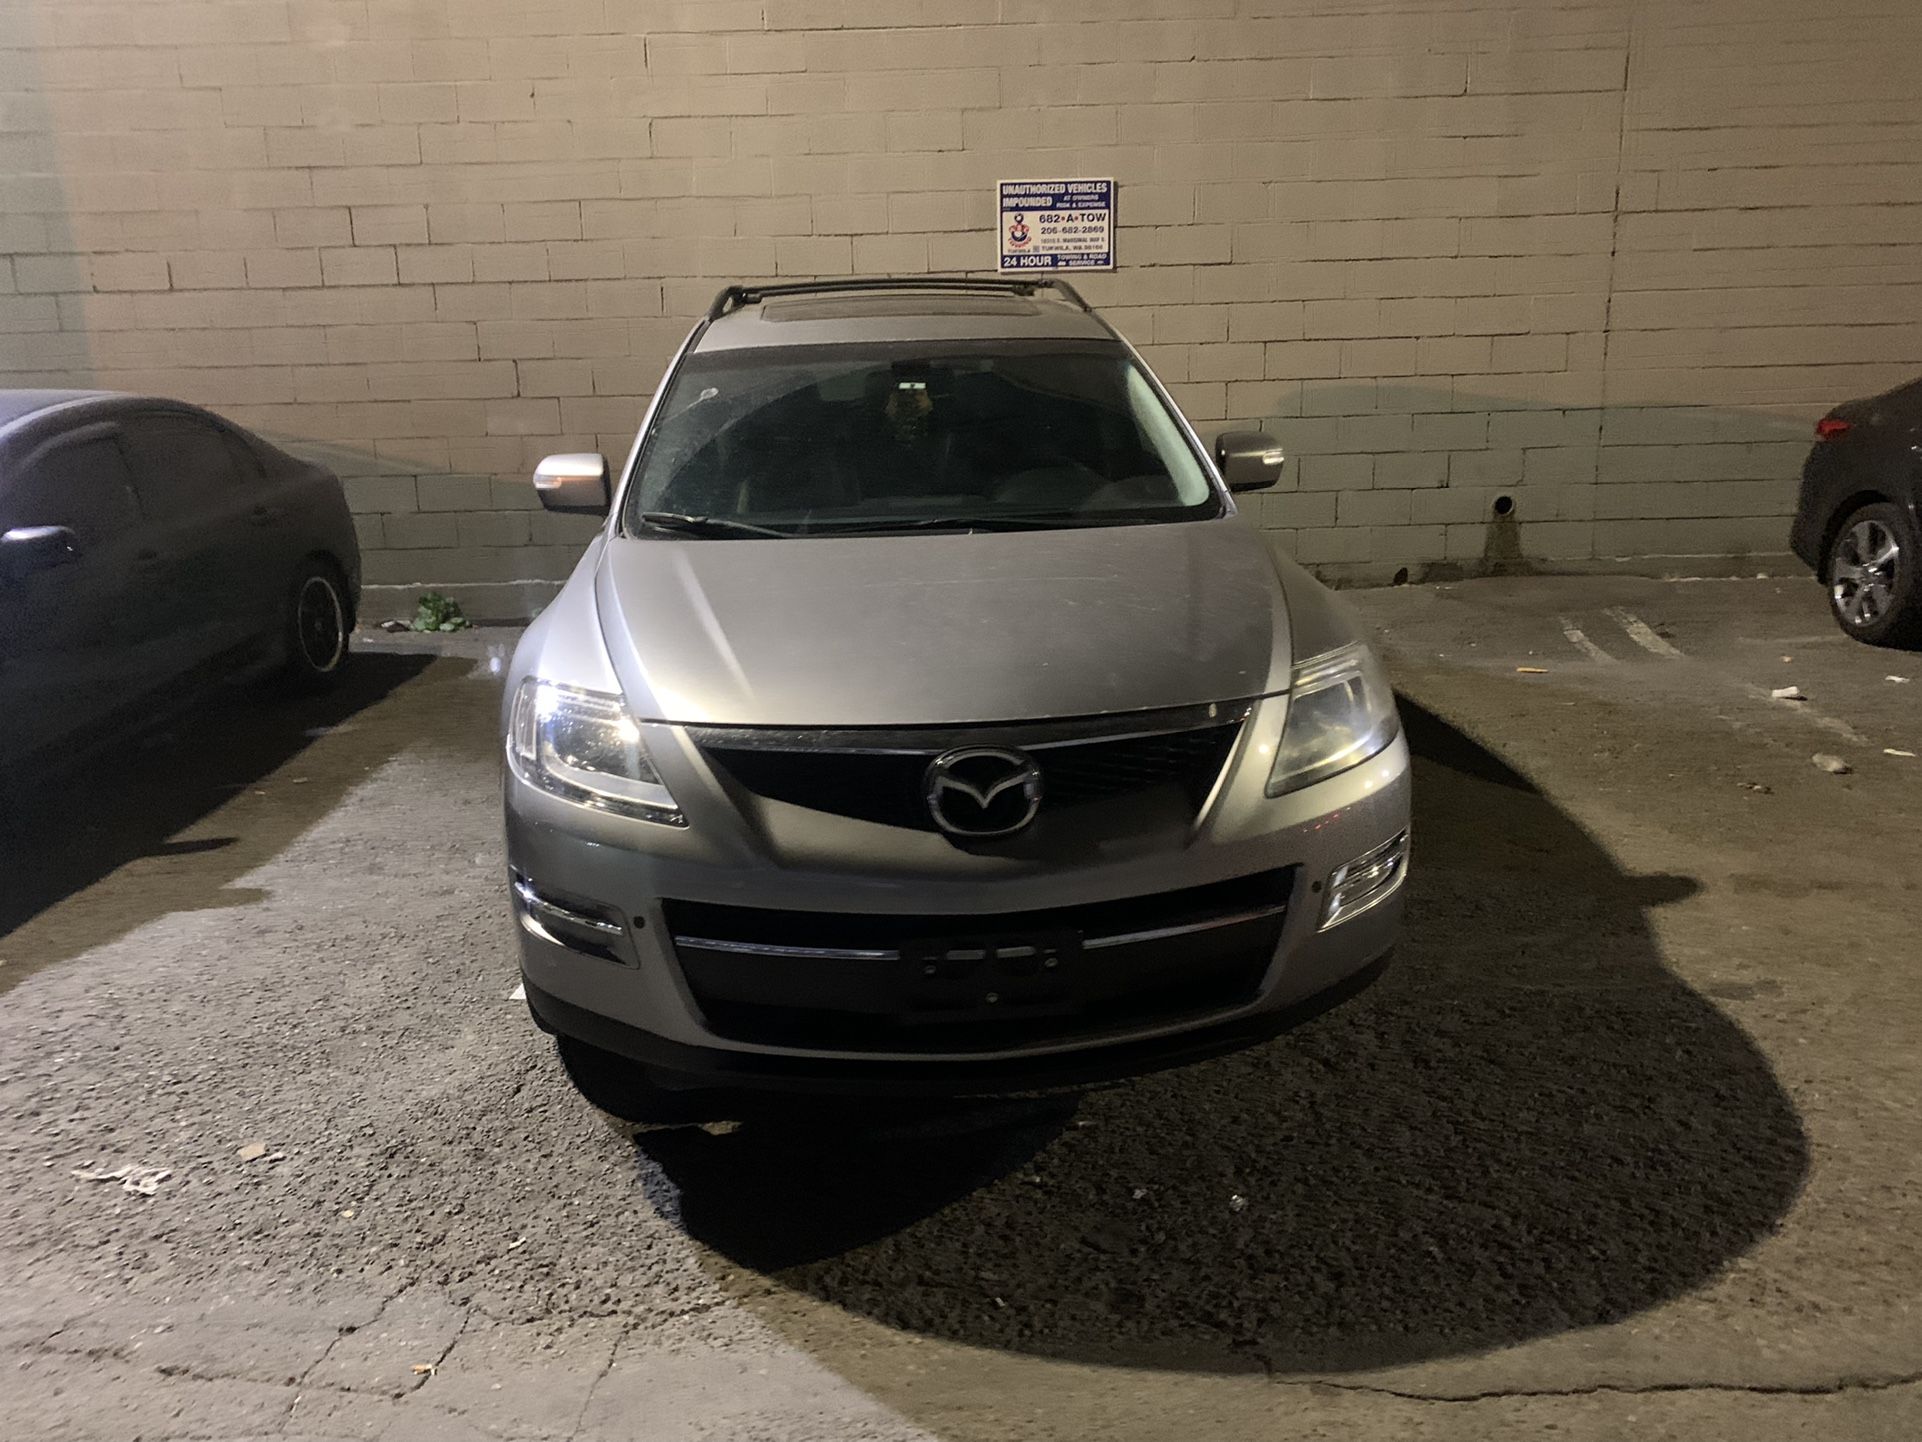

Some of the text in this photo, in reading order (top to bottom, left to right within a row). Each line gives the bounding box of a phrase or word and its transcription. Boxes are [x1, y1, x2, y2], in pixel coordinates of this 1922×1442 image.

[1002, 182, 1107, 195] UNAUTHORIZED VEHICLES
[1002, 196, 1052, 207] IMPOUNDED
[1040, 226, 1105, 235] 206-682-2869
[1003, 256, 1052, 267] 24 HOUR
